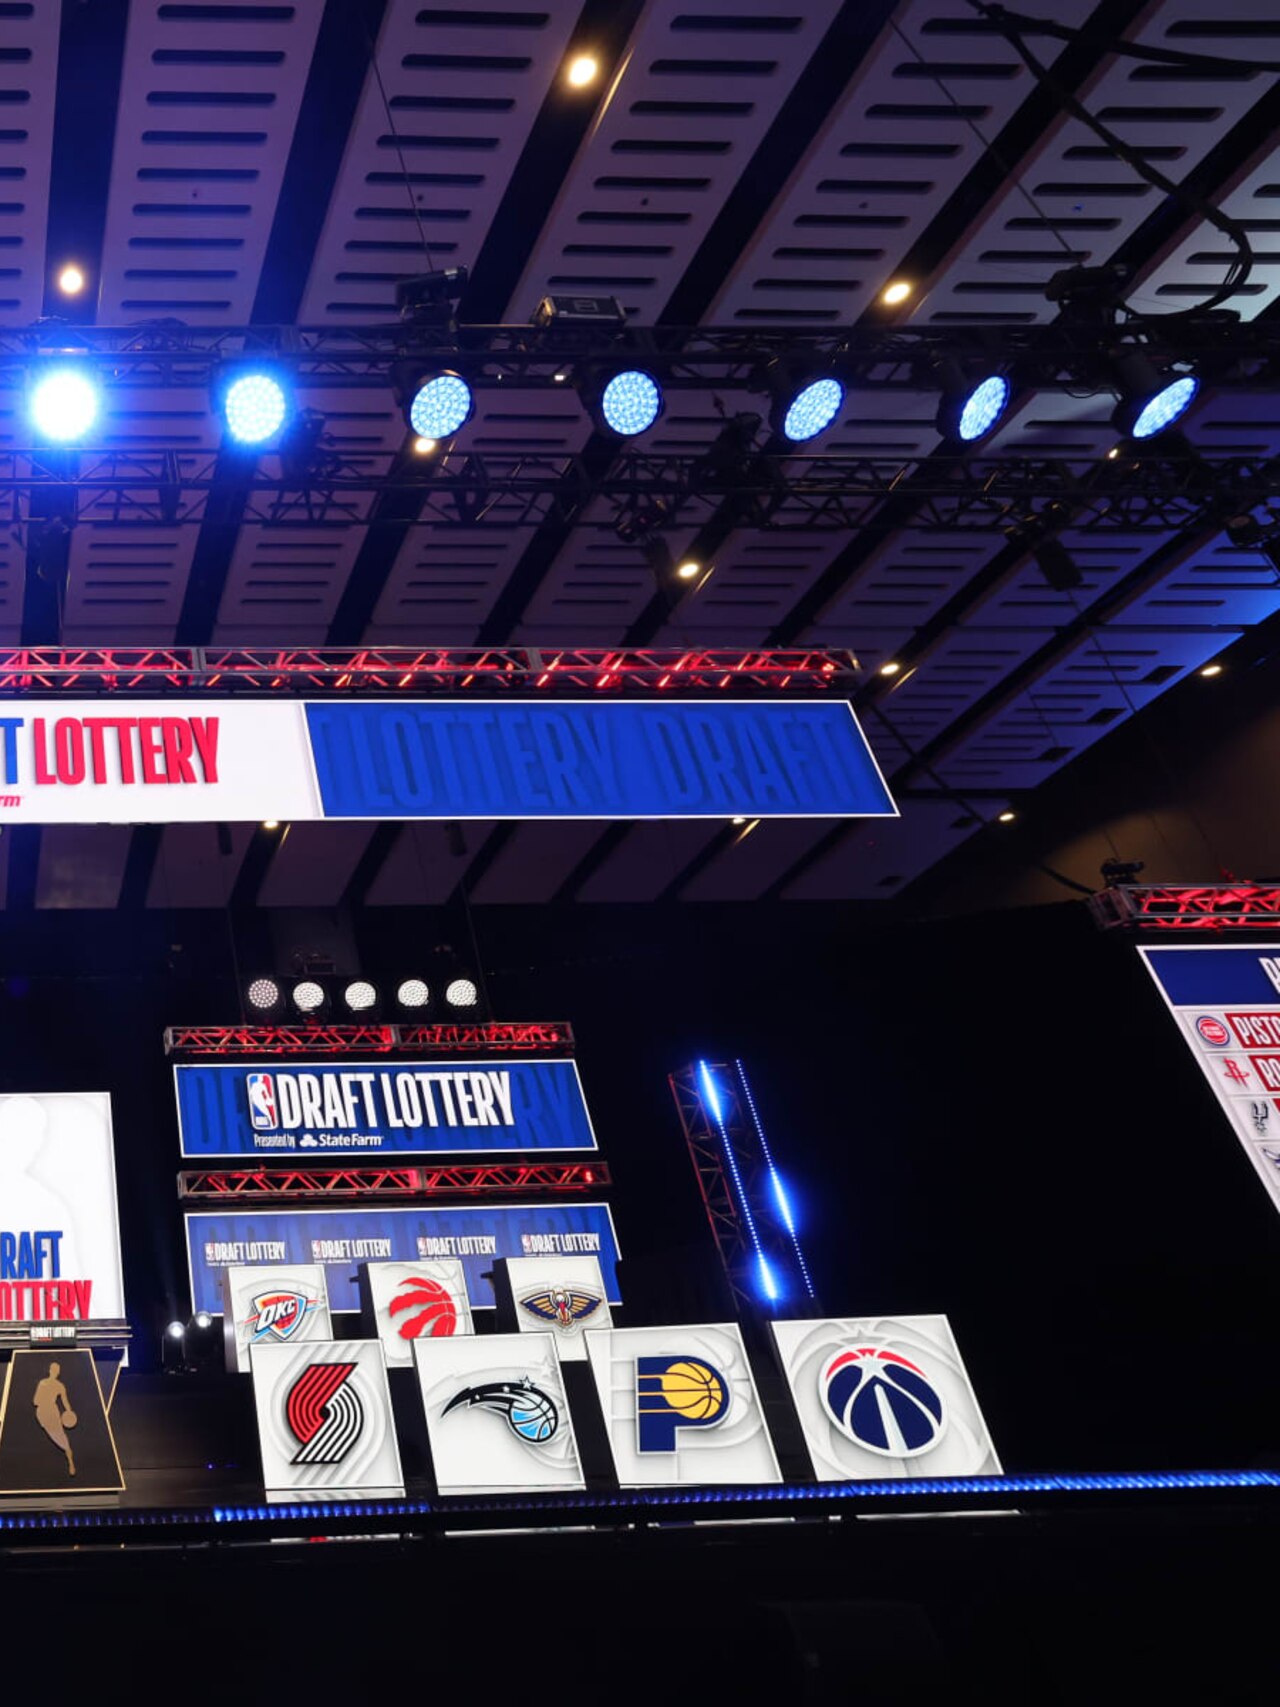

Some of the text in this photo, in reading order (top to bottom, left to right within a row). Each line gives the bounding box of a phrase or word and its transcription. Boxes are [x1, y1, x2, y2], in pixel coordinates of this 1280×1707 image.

[33, 717, 219, 785] LOTTERY
[348, 710, 856, 808] LOTTERY DRAFT
[276, 1073, 378, 1129] DRAFT
[380, 1071, 515, 1127] LOTTERY
[215, 1241, 285, 1260] DRAFT LOTTERY
[321, 1239, 391, 1258] DRAFT LOTTERY
[426, 1236, 496, 1255] DRAFT LOTTERY
[530, 1233, 600, 1252] DRAFT LOTTERY
[256, 1299, 296, 1331] OKC
